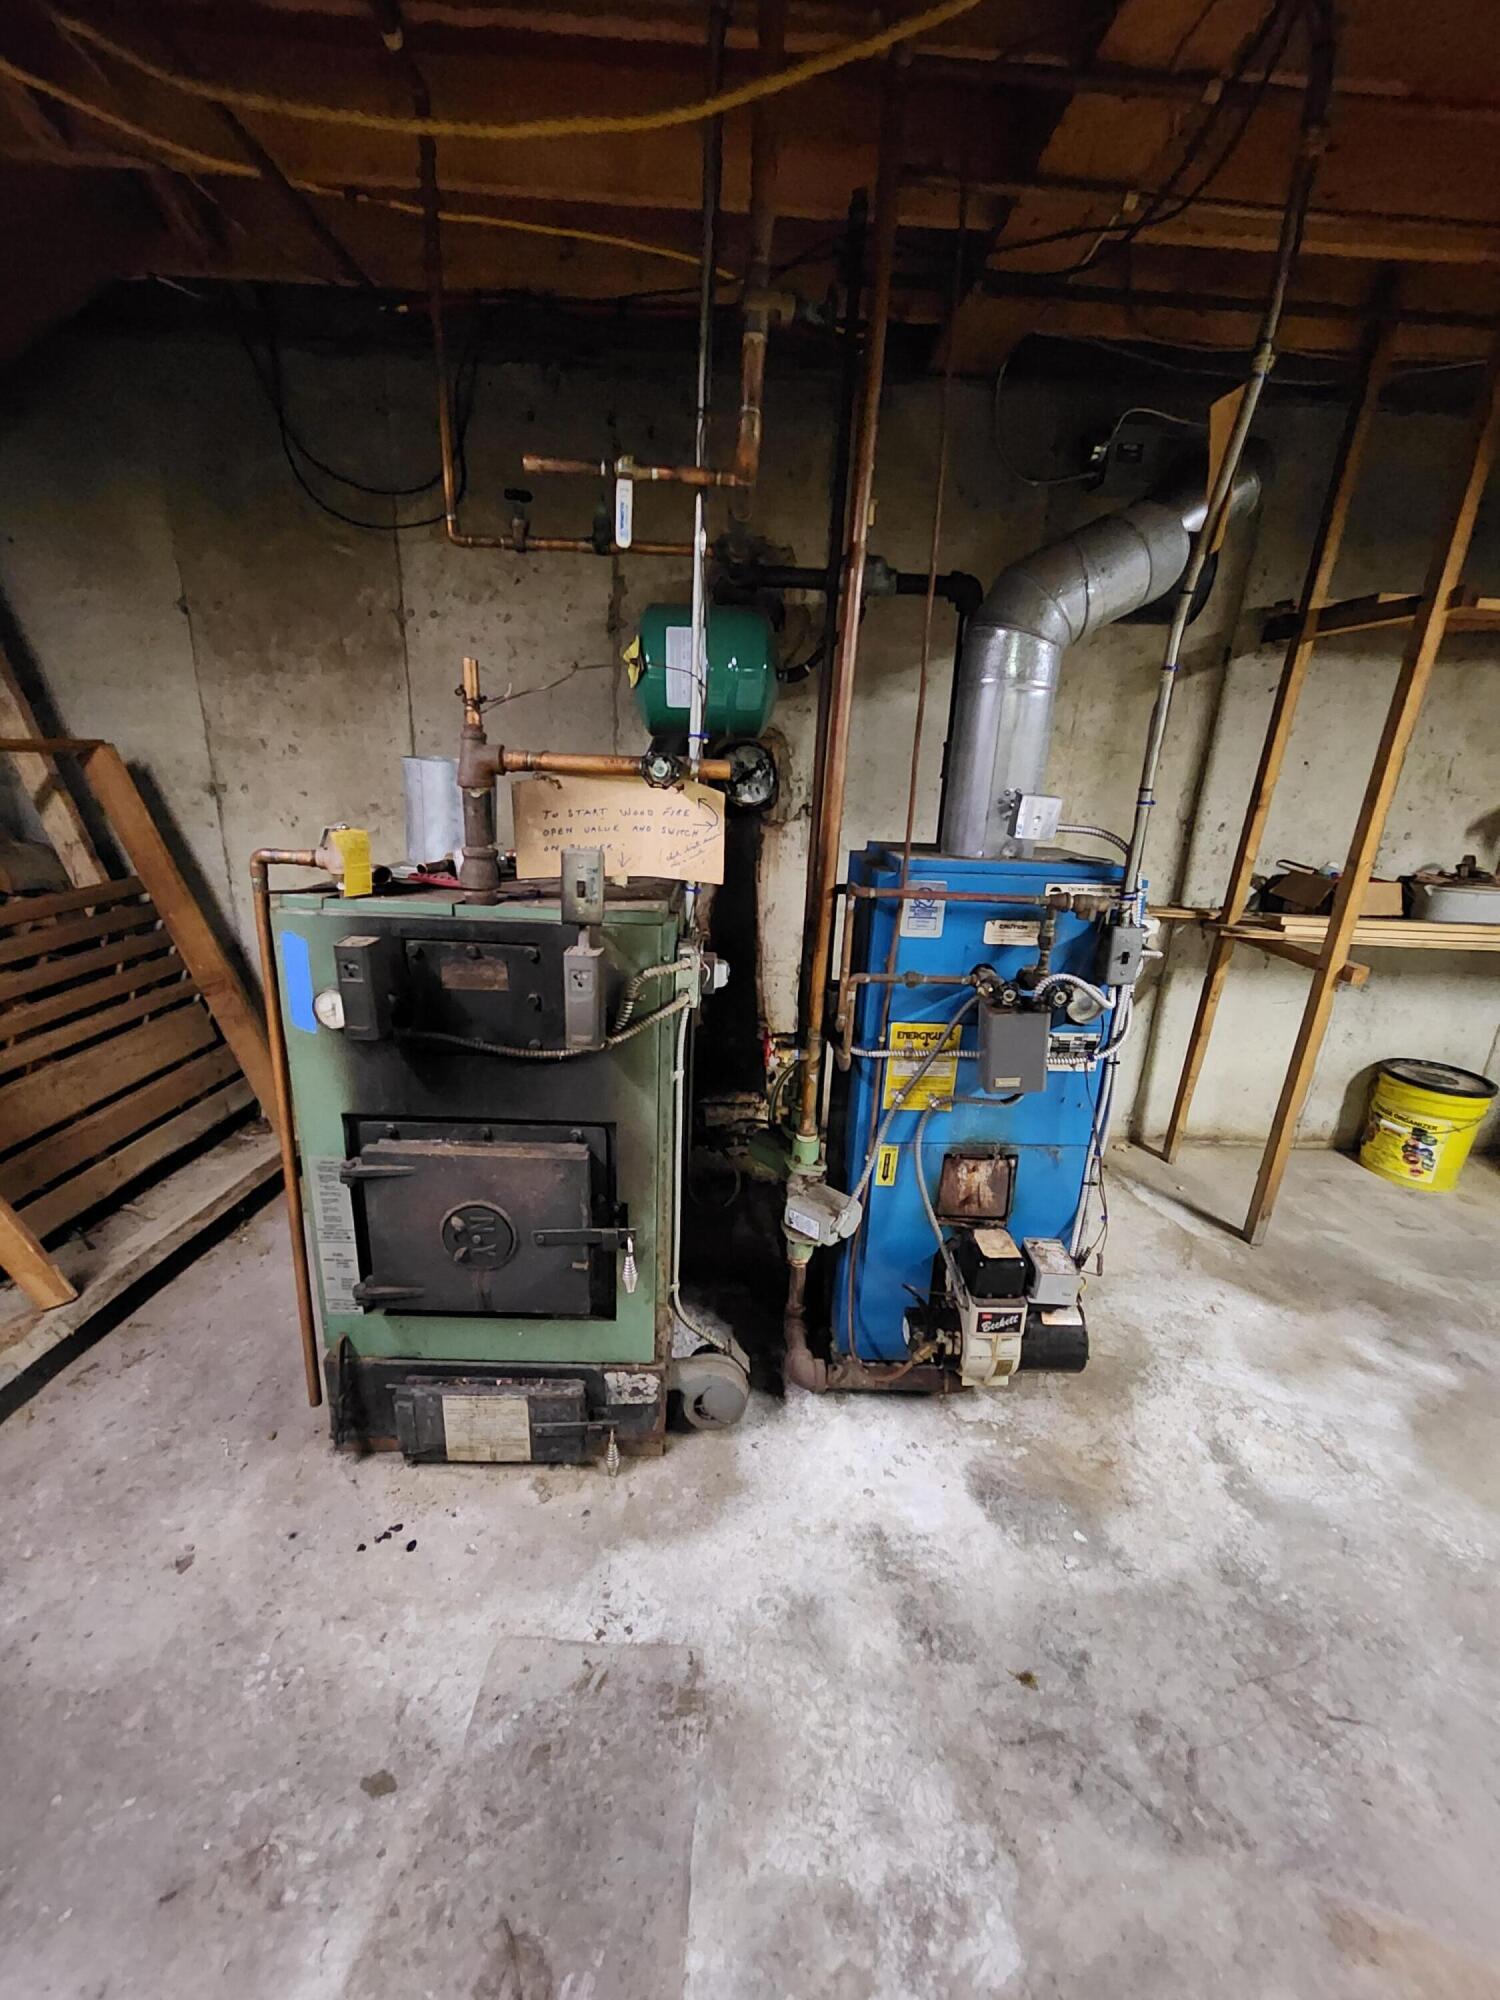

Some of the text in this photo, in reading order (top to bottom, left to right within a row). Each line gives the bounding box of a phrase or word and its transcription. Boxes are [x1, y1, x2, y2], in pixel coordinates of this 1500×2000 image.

[567, 807, 608, 818] START
[619, 807, 654, 817] WOOD
[662, 806, 691, 817] FIRE
[542, 825, 573, 837] OPEN
[631, 824, 652, 833] AND
[661, 825, 700, 838] SWITCH
[980, 1314, 1019, 1333] Beckett
